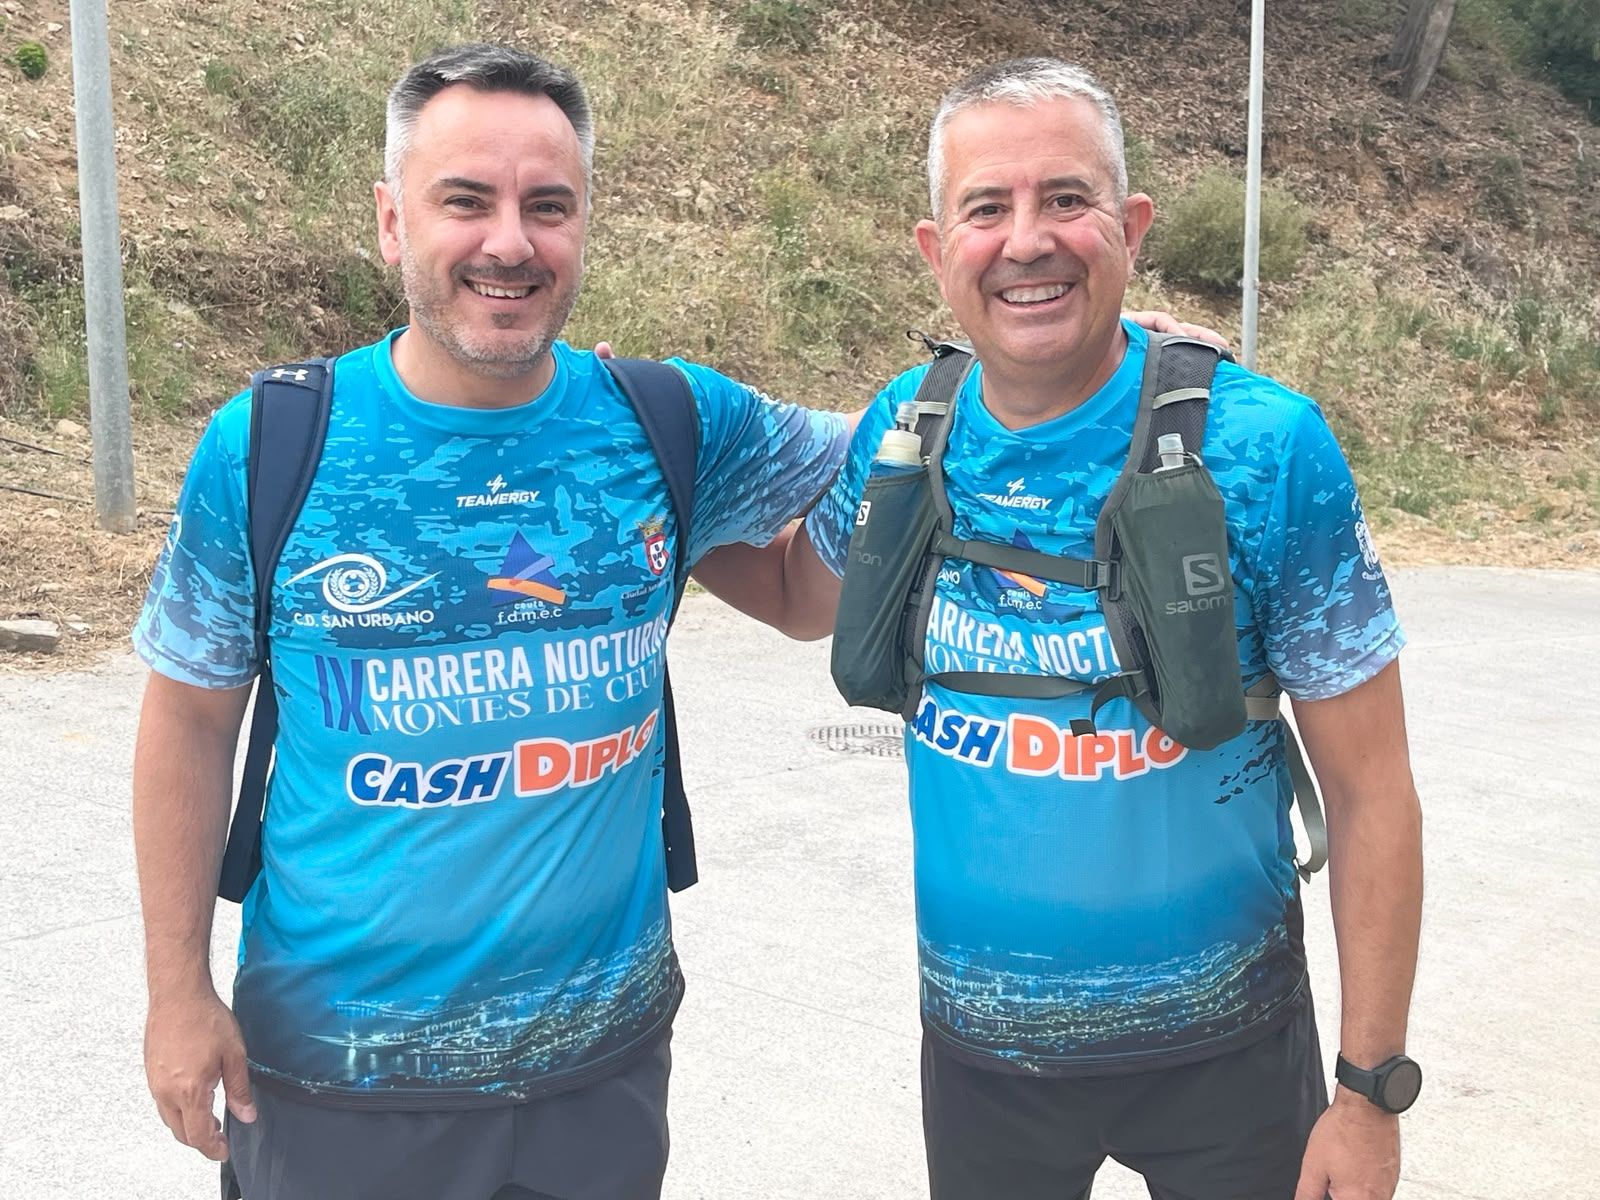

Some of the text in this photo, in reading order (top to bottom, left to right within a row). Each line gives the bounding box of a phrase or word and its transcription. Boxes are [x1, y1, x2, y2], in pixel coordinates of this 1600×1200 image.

[456, 490, 540, 508] TEAMERGY
[1165, 595, 1230, 615] salom
[1186, 556, 1221, 592] S
[294, 609, 435, 628] C.D. SAN URBANO
[926, 600, 1031, 666] ARRERA
[314, 655, 372, 736] IX
[366, 646, 534, 702] CARRERA
[371, 654, 662, 737] MONTES DE CEUT
[347, 708, 659, 808] CASH DIPLO
[911, 695, 1189, 781] ASH DIPLO
